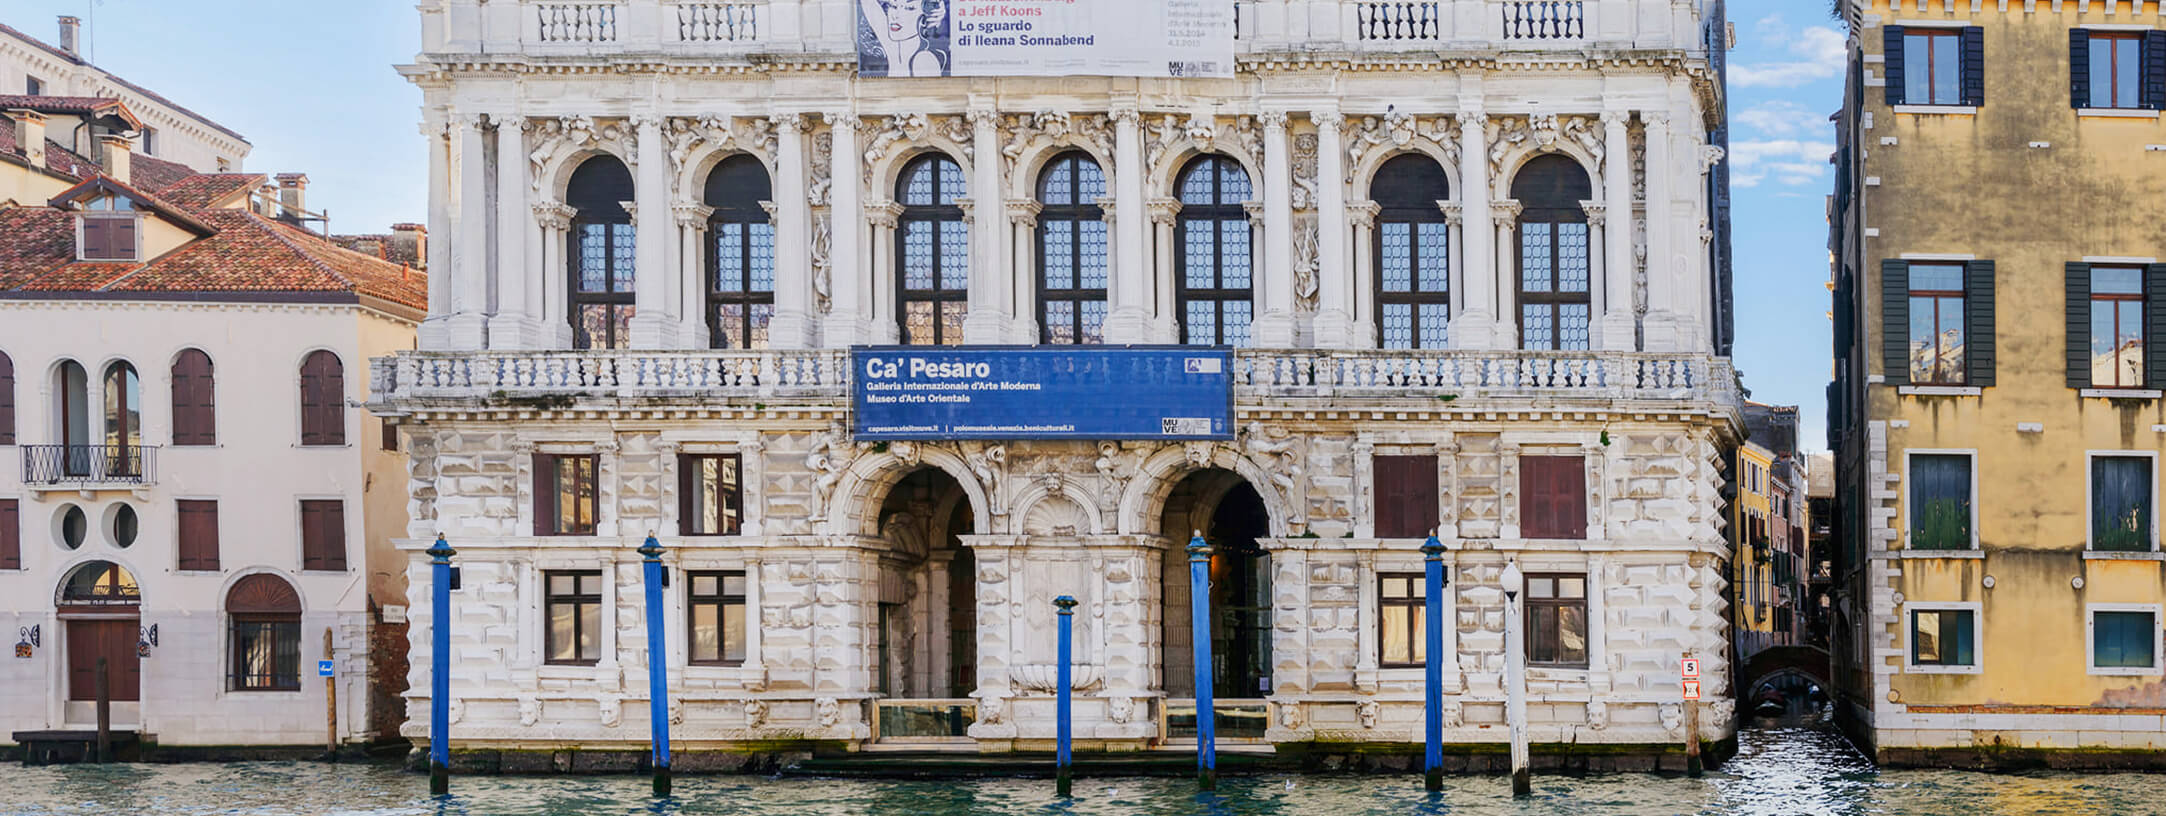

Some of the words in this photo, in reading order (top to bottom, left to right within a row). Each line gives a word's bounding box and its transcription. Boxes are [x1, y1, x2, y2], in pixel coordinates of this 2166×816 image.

[958, 8, 966, 16] a
[970, 5, 996, 17] Jeff
[1000, 6, 1042, 17] Koons
[959, 20, 974, 31] Lo
[978, 20, 1032, 33] sguardo
[958, 35, 971, 46] di
[975, 35, 1016, 46] Ileana
[1020, 35, 1095, 46] Sonnabend
[910, 358, 991, 379] Pesaro
[867, 382, 902, 391] Galleria
[904, 382, 969, 391] Internazionale
[971, 382, 998, 391] d'Arte
[1000, 382, 1041, 391] Moderna
[867, 394, 897, 403] Museo
[898, 394, 926, 403] d'Arte
[928, 394, 971, 403] Orientale
[1687, 662, 1694, 671] 5
